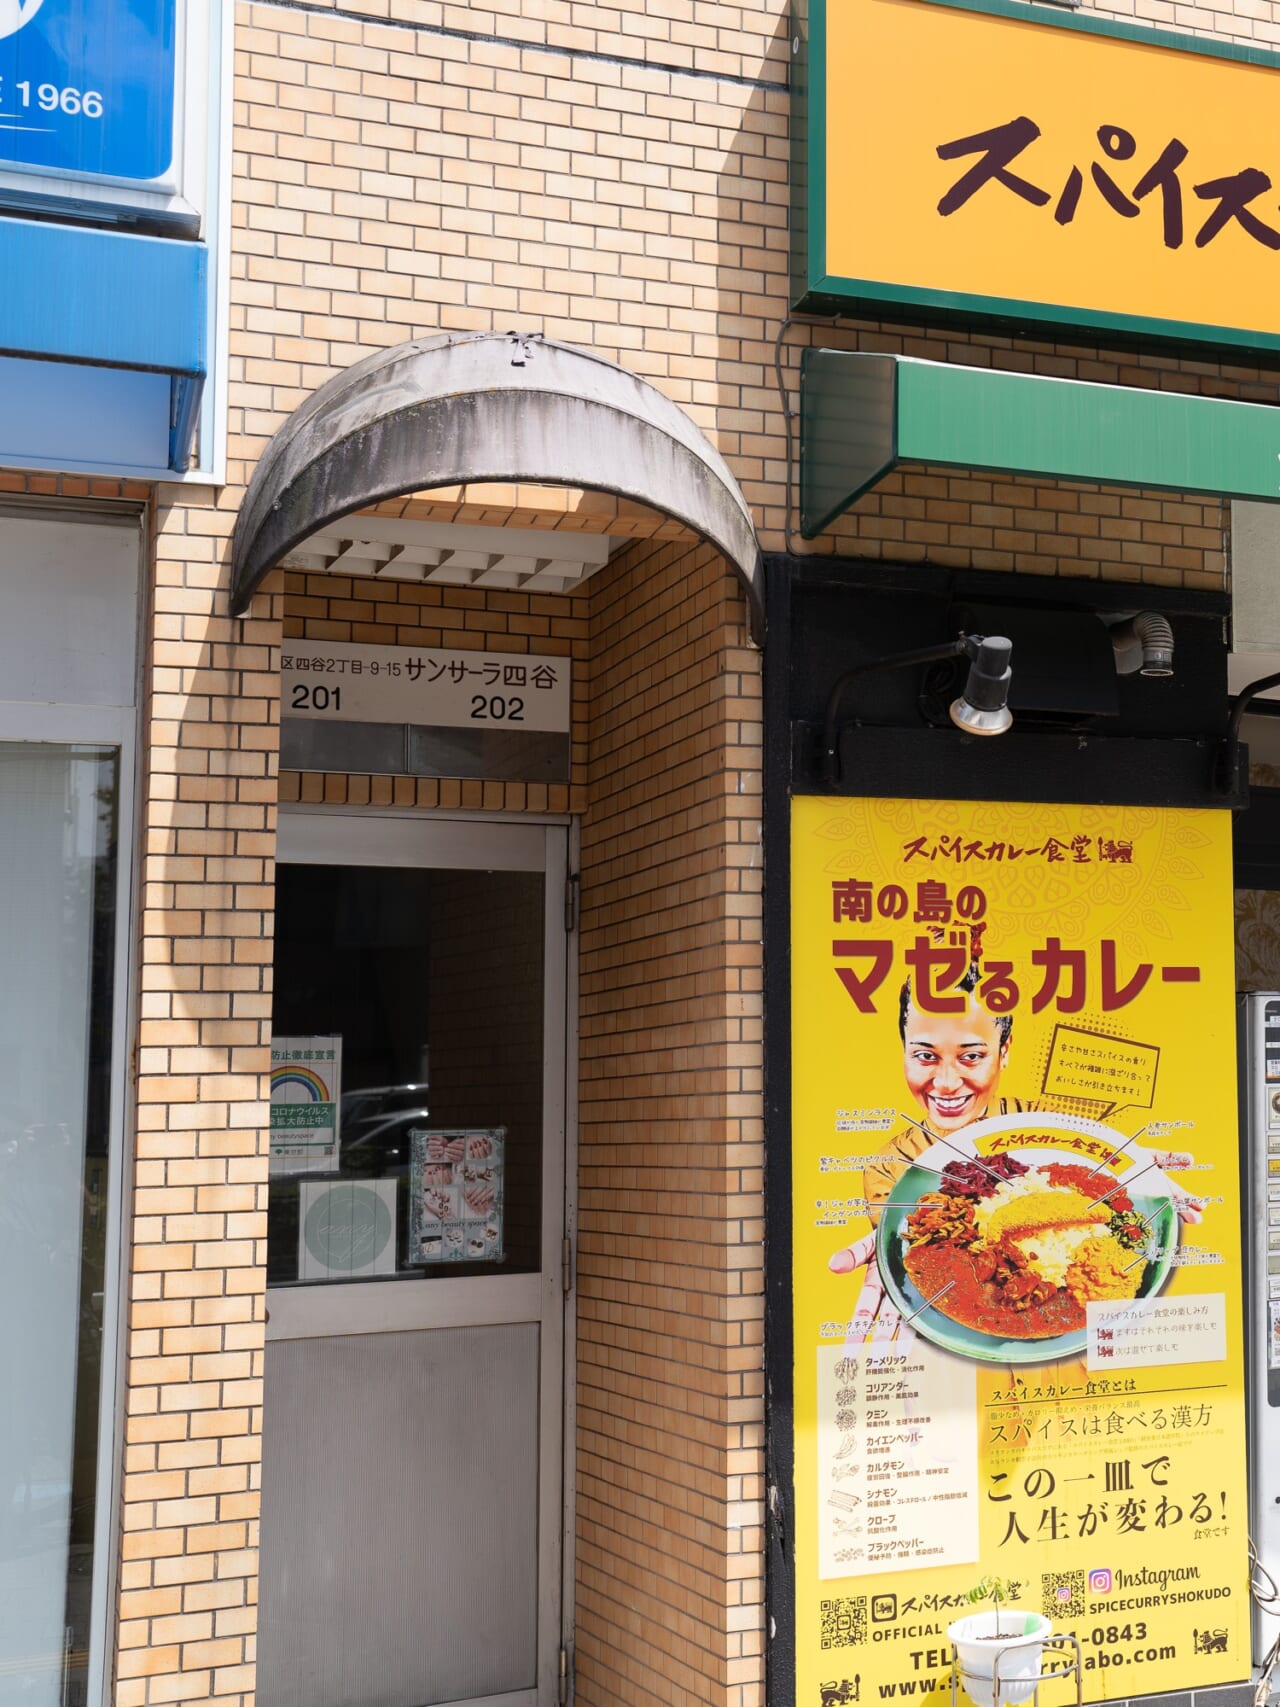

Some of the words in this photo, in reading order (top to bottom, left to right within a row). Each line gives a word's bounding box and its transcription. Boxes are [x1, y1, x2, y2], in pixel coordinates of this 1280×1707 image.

[16, 80, 104, 119] 1966
[405, 656, 557, 690] サンサーラ四谷
[291, 684, 342, 711] 201
[470, 695, 525, 721] 202
[902, 835, 1092, 864] スパイスカレー食堂
[831, 878, 987, 924] 南の島の
[831, 933, 1201, 1014] マゼるカレー
[271, 1106, 329, 1117] コロナウイルス
[989, 1134, 1102, 1154] スパイスカレー食堂
[865, 1355, 907, 1367] ターメリック
[866, 1382, 909, 1393] コリアンダー
[991, 1378, 1137, 1402] スパイスカレー食堂とは
[866, 1409, 889, 1420] クミン
[989, 1403, 1213, 1444] スパイスは食べる漢方
[866, 1432, 924, 1447] カイエンペッパー
[867, 1460, 905, 1473] カルダモン
[988, 1455, 1171, 1502] この一皿で
[867, 1488, 898, 1499] シナモン
[867, 1514, 897, 1526] クローブ
[998, 1491, 1227, 1548] 人生が変わる!
[867, 1537, 925, 1552] ブラックペッパー
[1194, 1527, 1231, 1541] 食堂です
[1114, 1566, 1201, 1590] Instagram
[1089, 1586, 1232, 1616] SPICECURRYSHOKUDO
[872, 1622, 944, 1643] OFFICIAL
